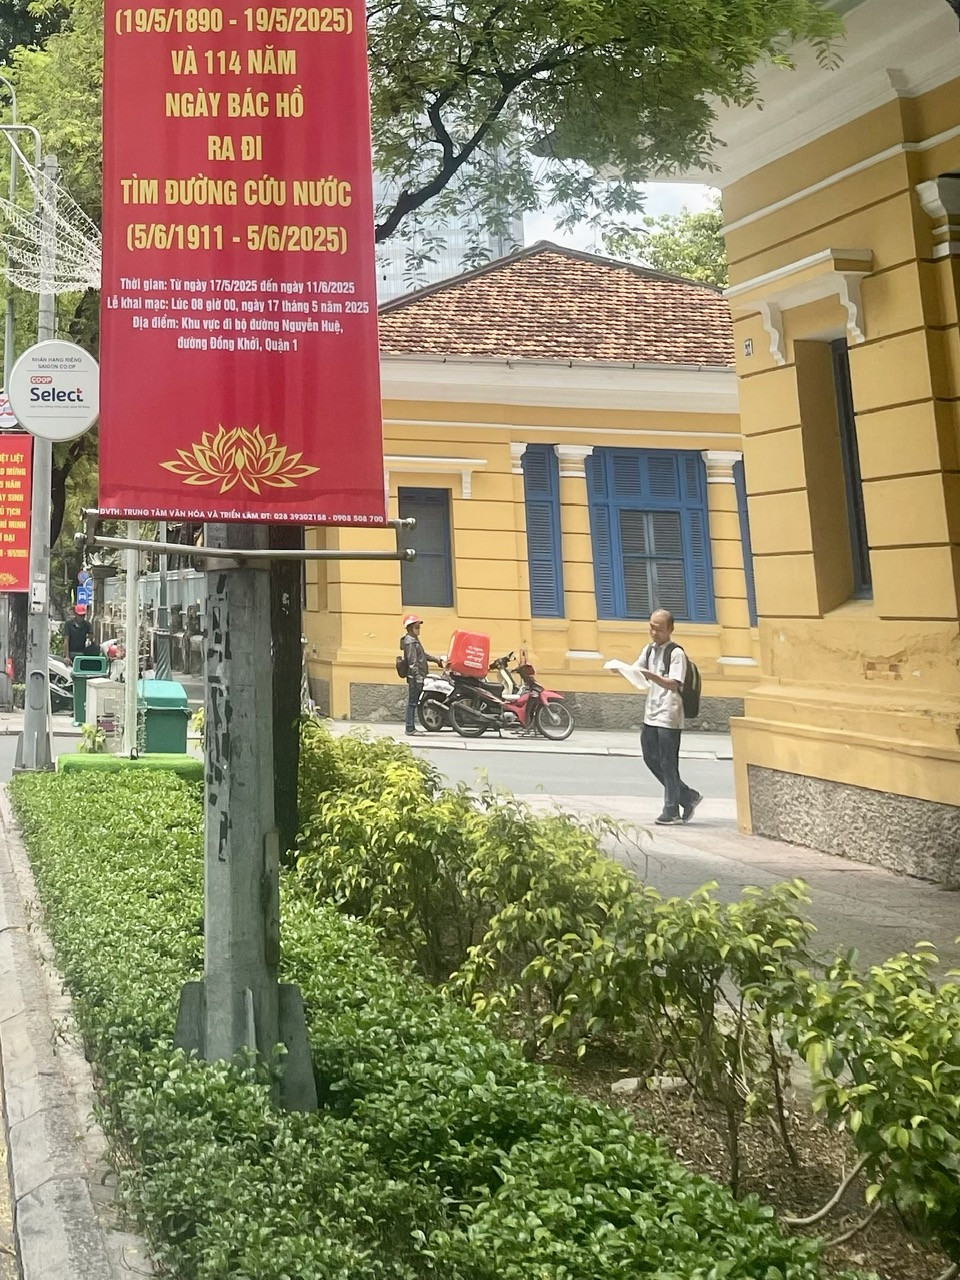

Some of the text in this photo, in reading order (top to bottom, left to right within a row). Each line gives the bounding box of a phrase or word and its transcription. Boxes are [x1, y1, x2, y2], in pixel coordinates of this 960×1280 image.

[115, 7, 223, 36] (19/5/1890
[244, 6, 353, 35] 19/5/2025)
[171, 44, 297, 75] VÀ 114 NĂM
[165, 84, 304, 118] NGÀY BÁC HỒ
[207, 136, 263, 161] RA ĐI
[120, 173, 352, 207] TÌM ĐƯỜNG CỨU NƯỚC
[127, 223, 223, 251] (5/6/1911
[247, 225, 348, 255] 5/6/2025)
[120, 277, 355, 294] Thời gian: Từ ngày 17/5/2025 đến ngày 11/6/2025
[107, 294, 369, 314] Lễ khai mạc: Lúc 08 giờ 00, ngày 17 tháng 5 năm 2025
[132, 314, 344, 334] Địa điểm: Khu vực đi bộ đường Nguyễn Huệ,
[177, 335, 298, 353] đường Đồng Khởi, Quận 1
[30, 387, 84, 402] Select
[100, 508, 121, 516] ĐVTH:
[124, 508, 149, 516] TRUNG
[152, 508, 168, 517] TÂM
[169, 508, 186, 517] VĂN
[188, 509, 205, 518] HÓA
[207, 509, 219, 519] VÀ
[220, 508, 241, 519] TRIỂN
[273, 512, 288, 520] 028
[333, 514, 352, 522] 0908
[353, 514, 367, 523] 508
[369, 515, 384, 523] 700
